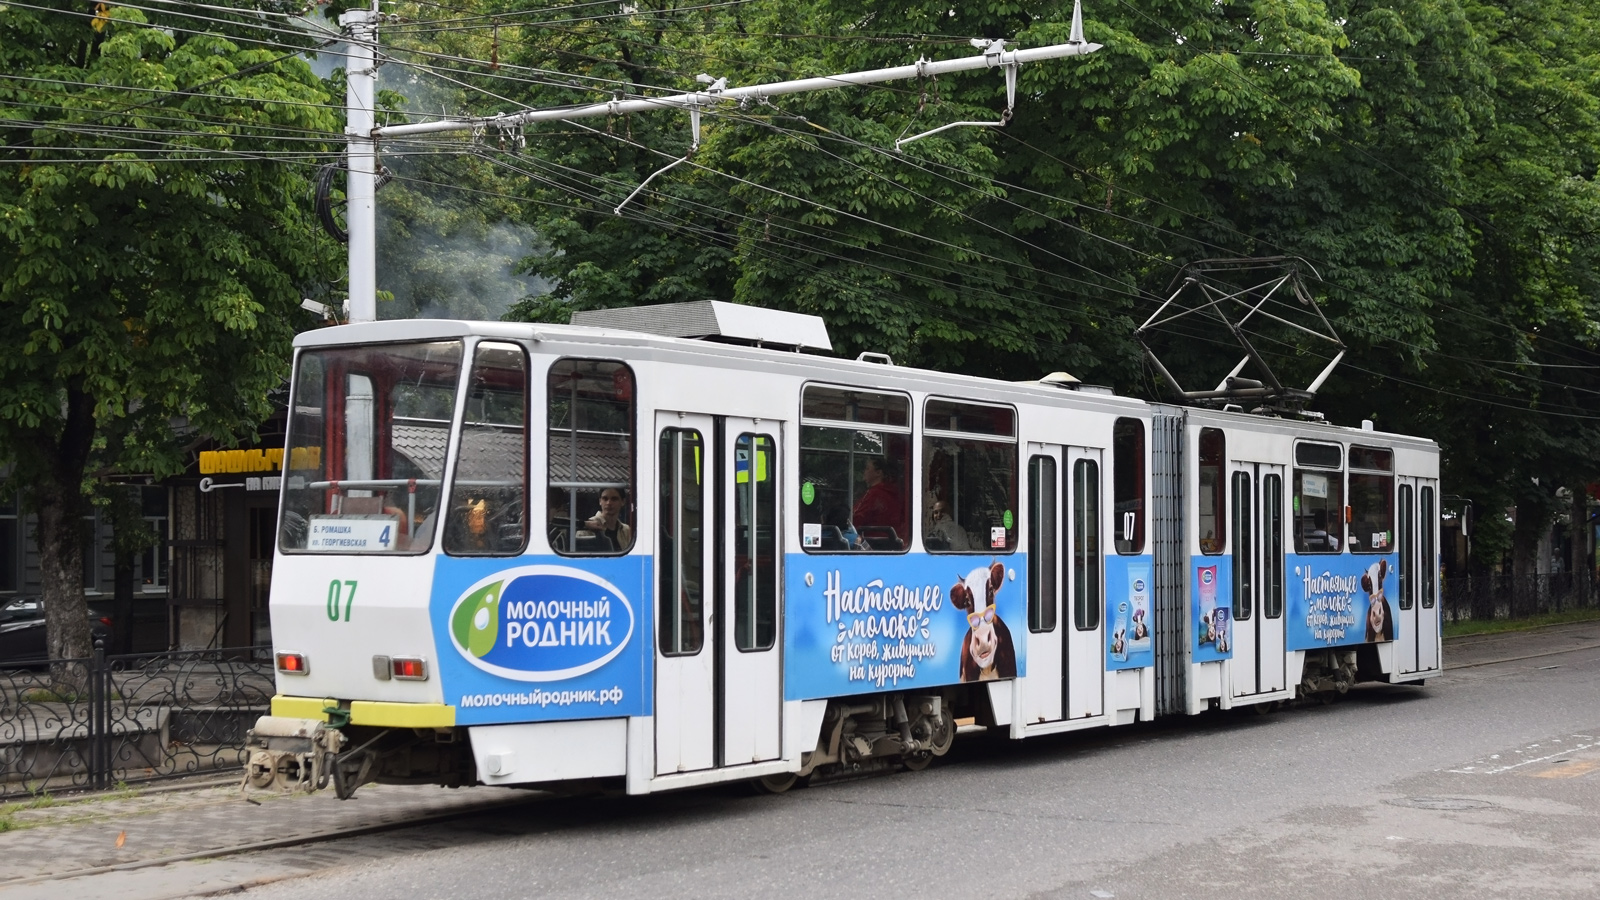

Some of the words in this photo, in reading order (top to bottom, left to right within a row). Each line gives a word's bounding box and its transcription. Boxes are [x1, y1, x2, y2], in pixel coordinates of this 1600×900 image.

[321, 525, 352, 534] РОМАШКА
[378, 525, 391, 547] 4
[1124, 512, 1135, 540] 07
[321, 538, 367, 547] ГЕОРГИЕВСКАЯ
[823, 569, 943, 623] Настоящее
[1303, 565, 1357, 600] Настоящее
[327, 579, 358, 622] 07
[506, 596, 611, 620] МОЛОЧНЫЙ
[506, 620, 612, 648] РОДНИК
[848, 613, 918, 640] молоко
[831, 645, 845, 662] от
[881, 638, 936, 665] живущих
[849, 666, 865, 681] на
[868, 663, 915, 688] курорте
[461, 686, 623, 708] молочныйродник.рф
